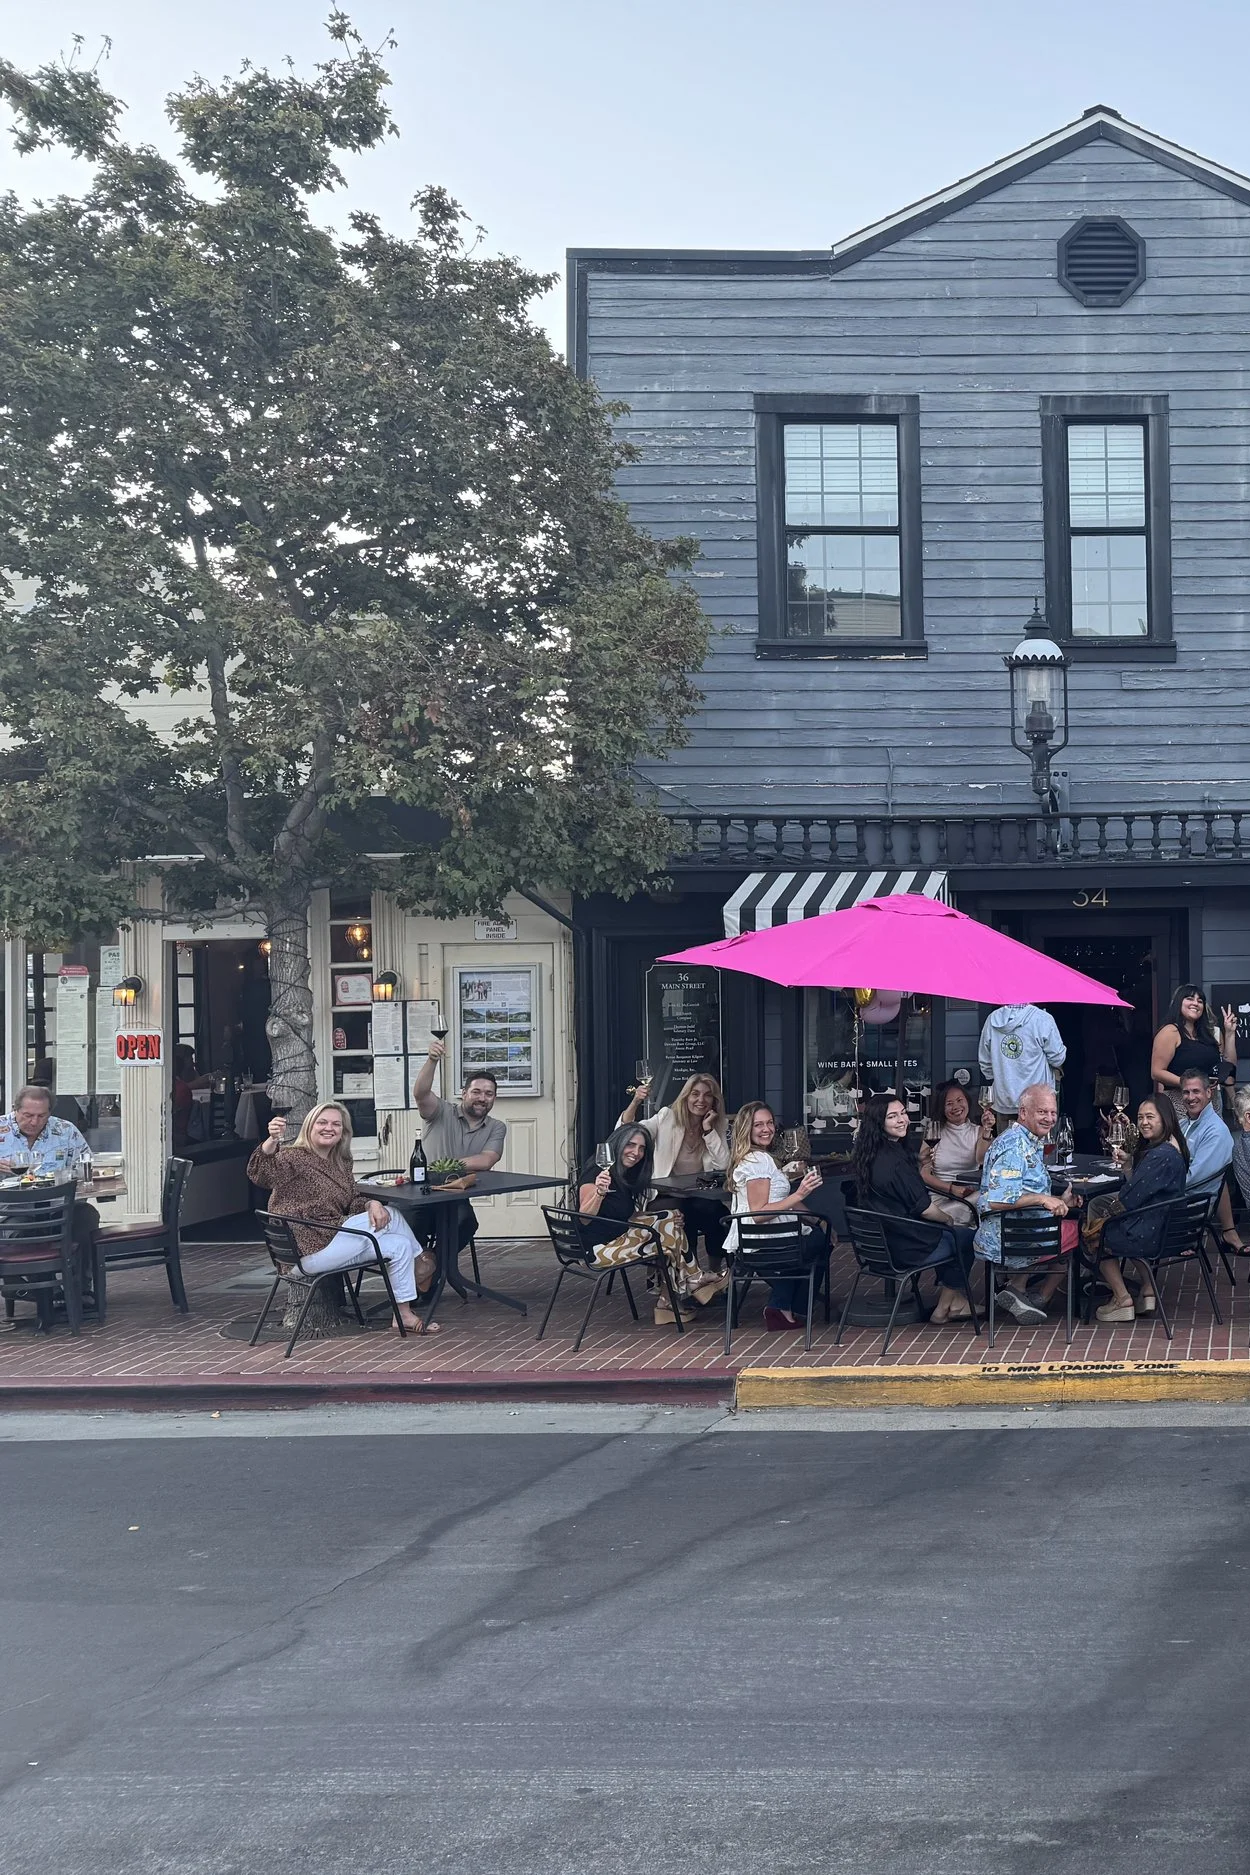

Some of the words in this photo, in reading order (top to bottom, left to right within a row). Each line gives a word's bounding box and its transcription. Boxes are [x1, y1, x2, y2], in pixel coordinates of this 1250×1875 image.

[1072, 888, 1109, 907] 34
[677, 973, 689, 982] 36
[116, 1034, 161, 1060] OPEN
[866, 1060, 893, 1068] SMALL
[1048, 1363, 1125, 1371] LOADING
[1133, 1362, 1181, 1370] ZONE
